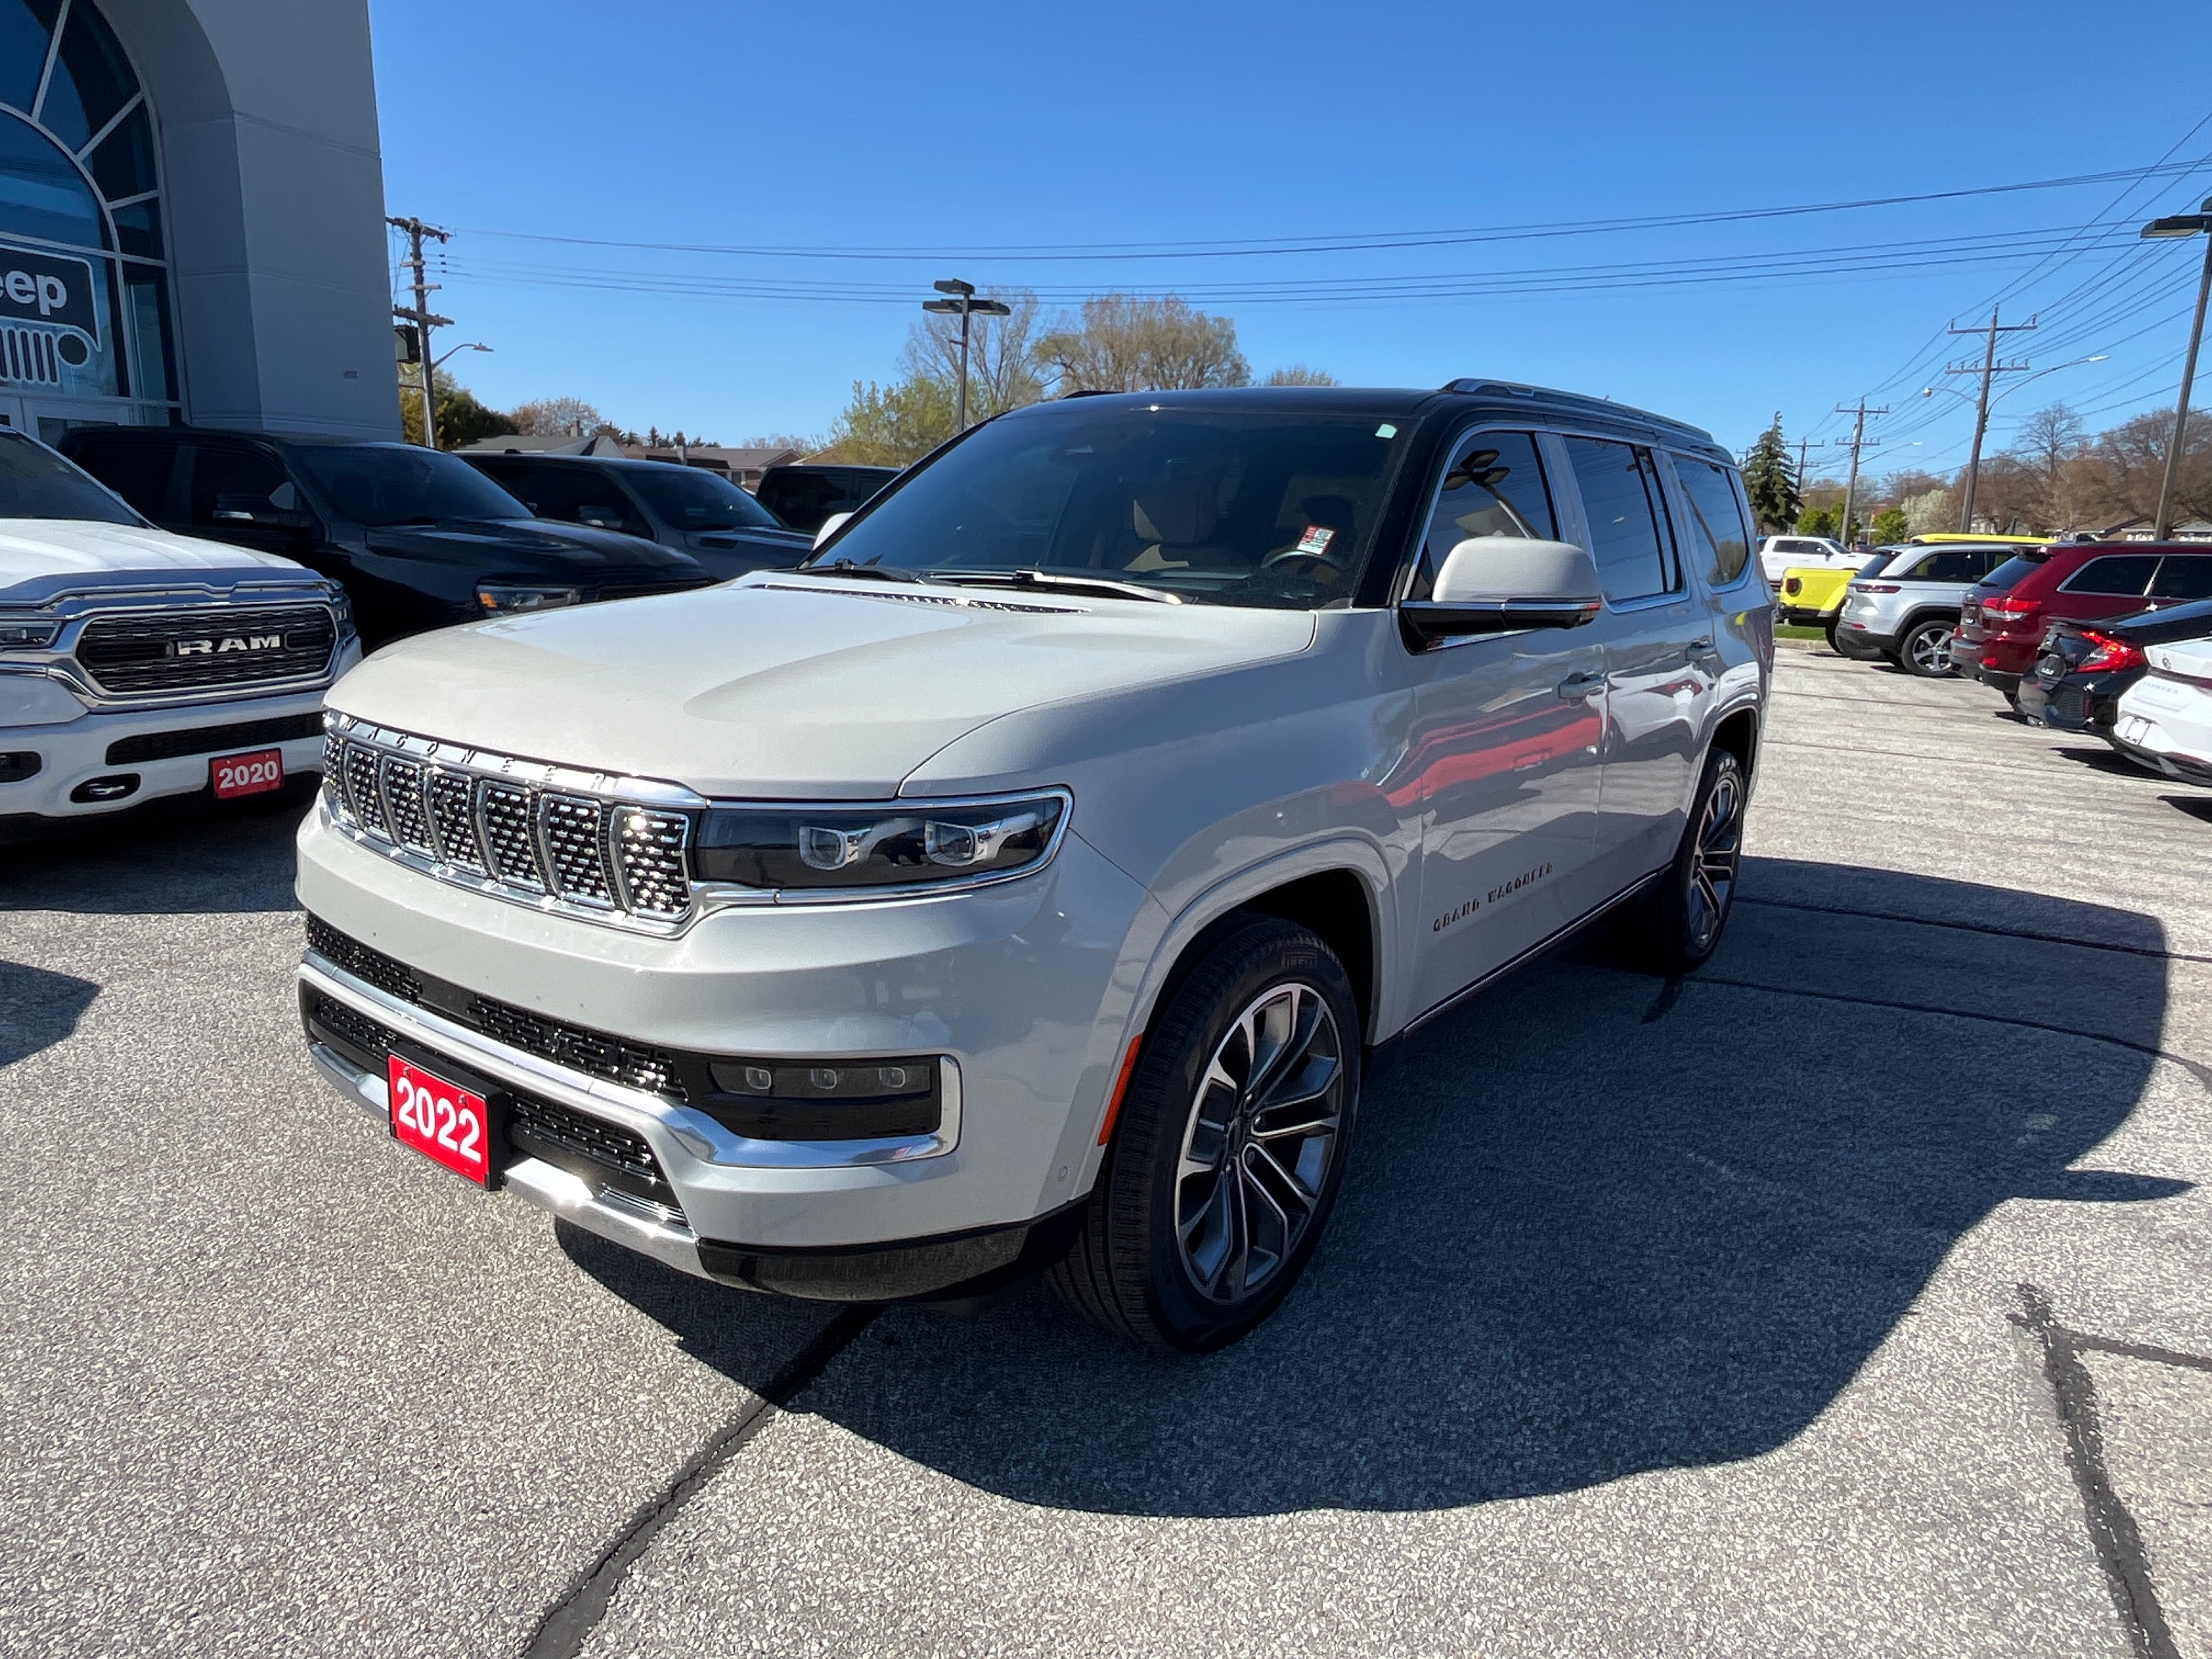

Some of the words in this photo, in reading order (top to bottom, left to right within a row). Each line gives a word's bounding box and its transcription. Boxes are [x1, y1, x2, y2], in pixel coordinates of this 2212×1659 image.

[177, 634, 280, 655] RAM
[343, 717, 606, 791] WAGONEER
[218, 760, 279, 789] 2020
[1433, 898, 1480, 932] GRAND
[397, 1076, 482, 1164] 2022
